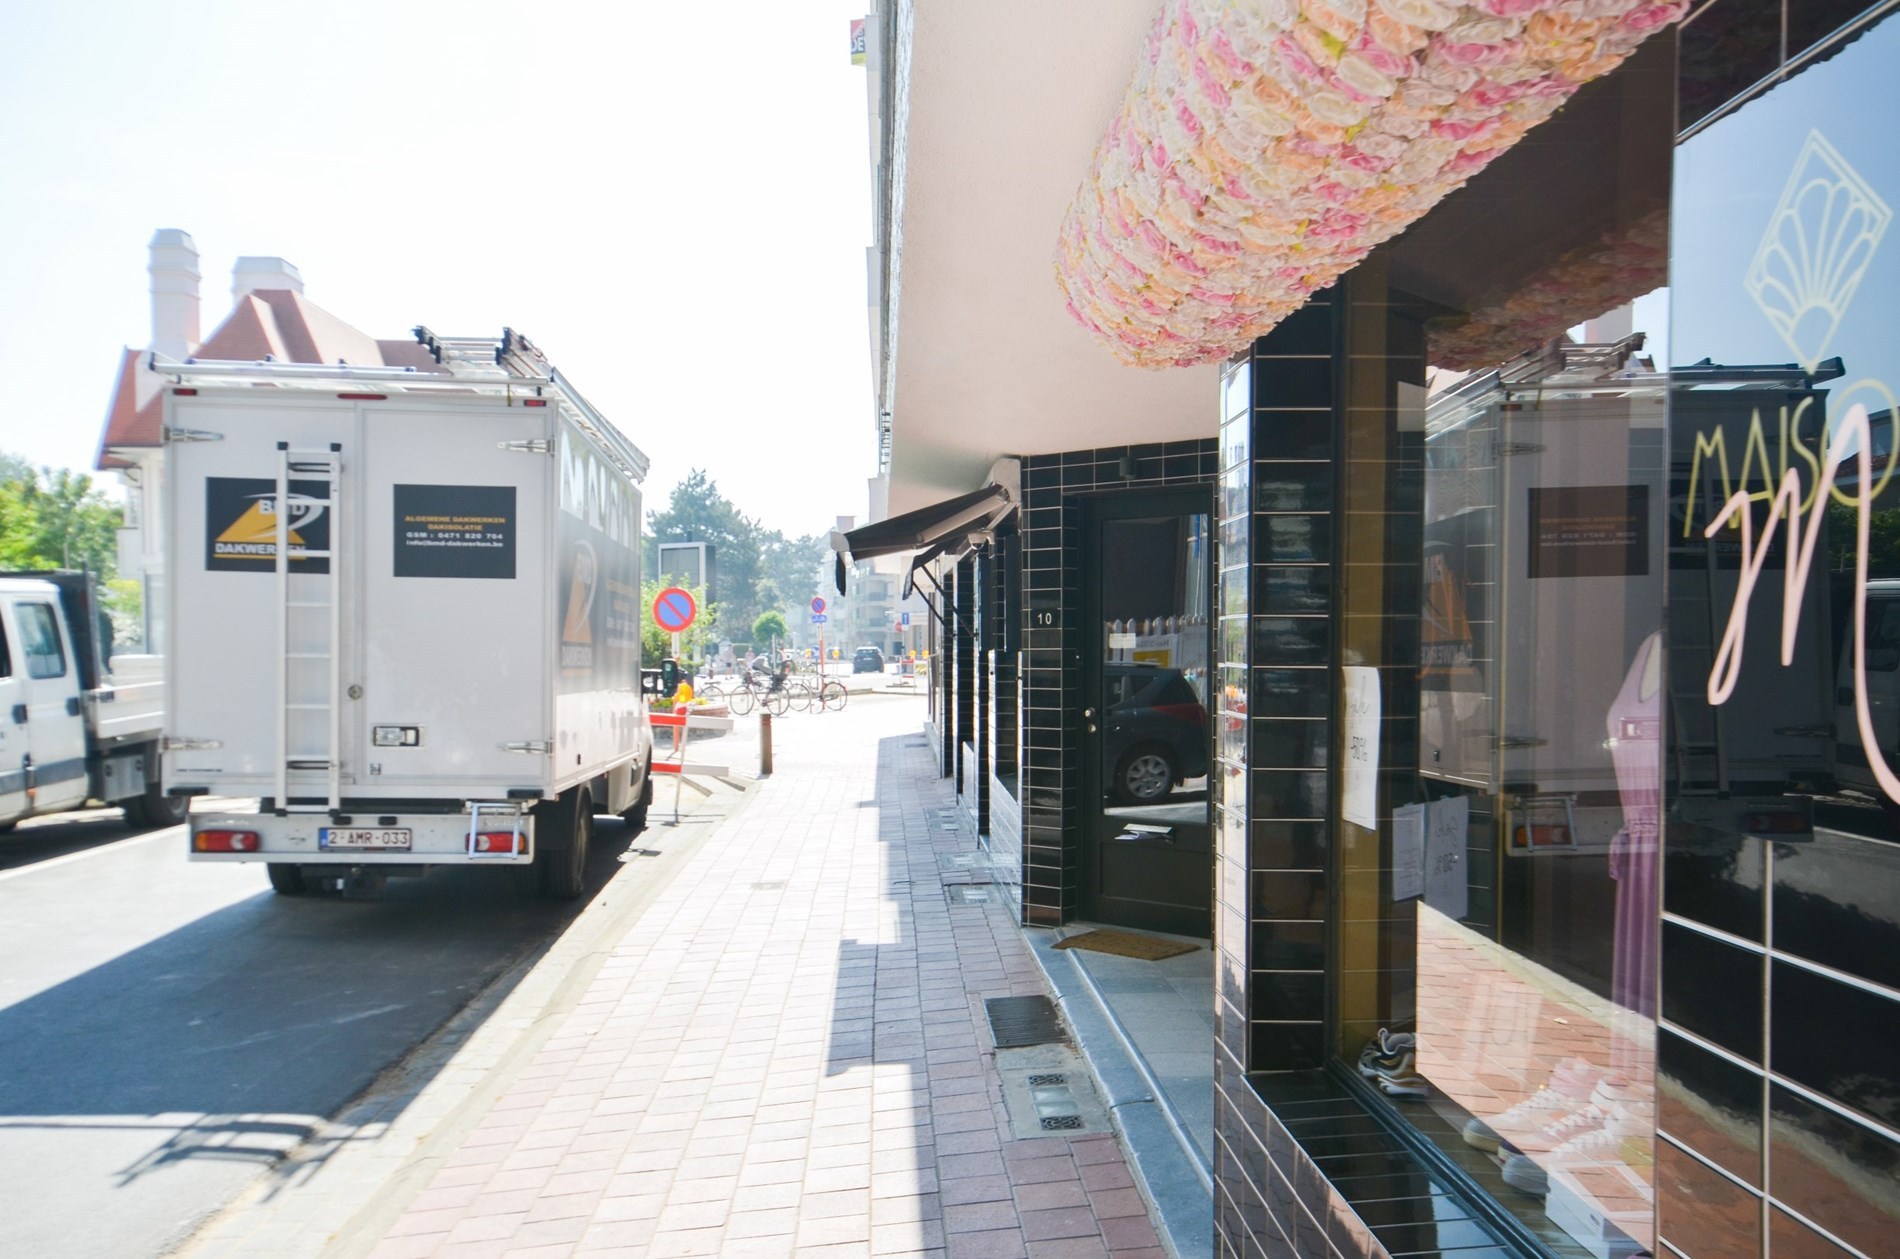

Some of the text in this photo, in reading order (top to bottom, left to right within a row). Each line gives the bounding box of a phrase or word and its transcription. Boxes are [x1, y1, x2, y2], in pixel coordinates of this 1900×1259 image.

[404, 515, 506, 525] ALGEMENE DAKWERKEN
[427, 523, 483, 531] DAKISOLATIE
[406, 531, 428, 539] GSM
[437, 532, 461, 540] 0471
[1037, 612, 1053, 625] 10
